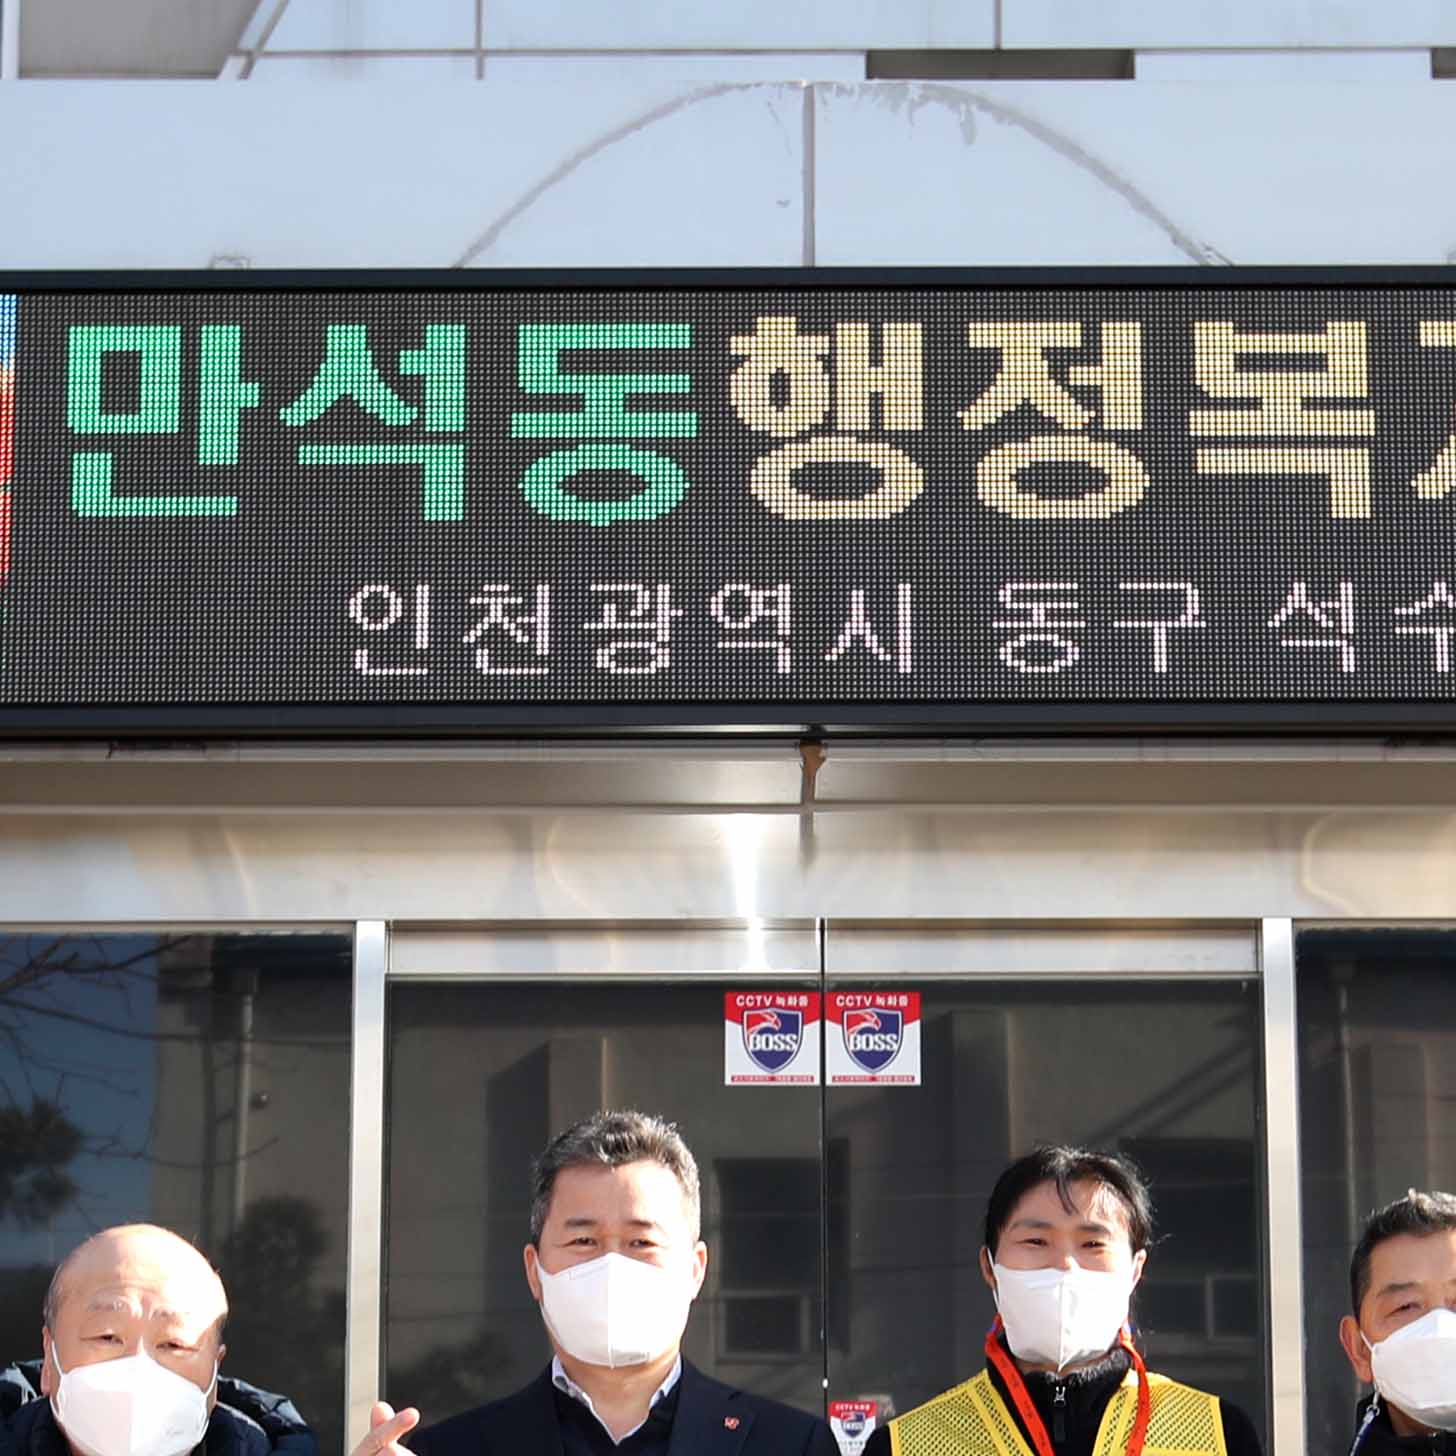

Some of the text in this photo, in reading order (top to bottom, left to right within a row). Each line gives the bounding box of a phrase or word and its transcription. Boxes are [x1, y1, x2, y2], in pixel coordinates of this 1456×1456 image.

[348, 583, 913, 679] 인천광역시
[992, 582, 1206, 675] 동구
[736, 995, 772, 1006] CCTV
[836, 995, 872, 1007] CCTV
[750, 1033, 798, 1052] BOSS
[849, 1033, 898, 1052] BOSS
